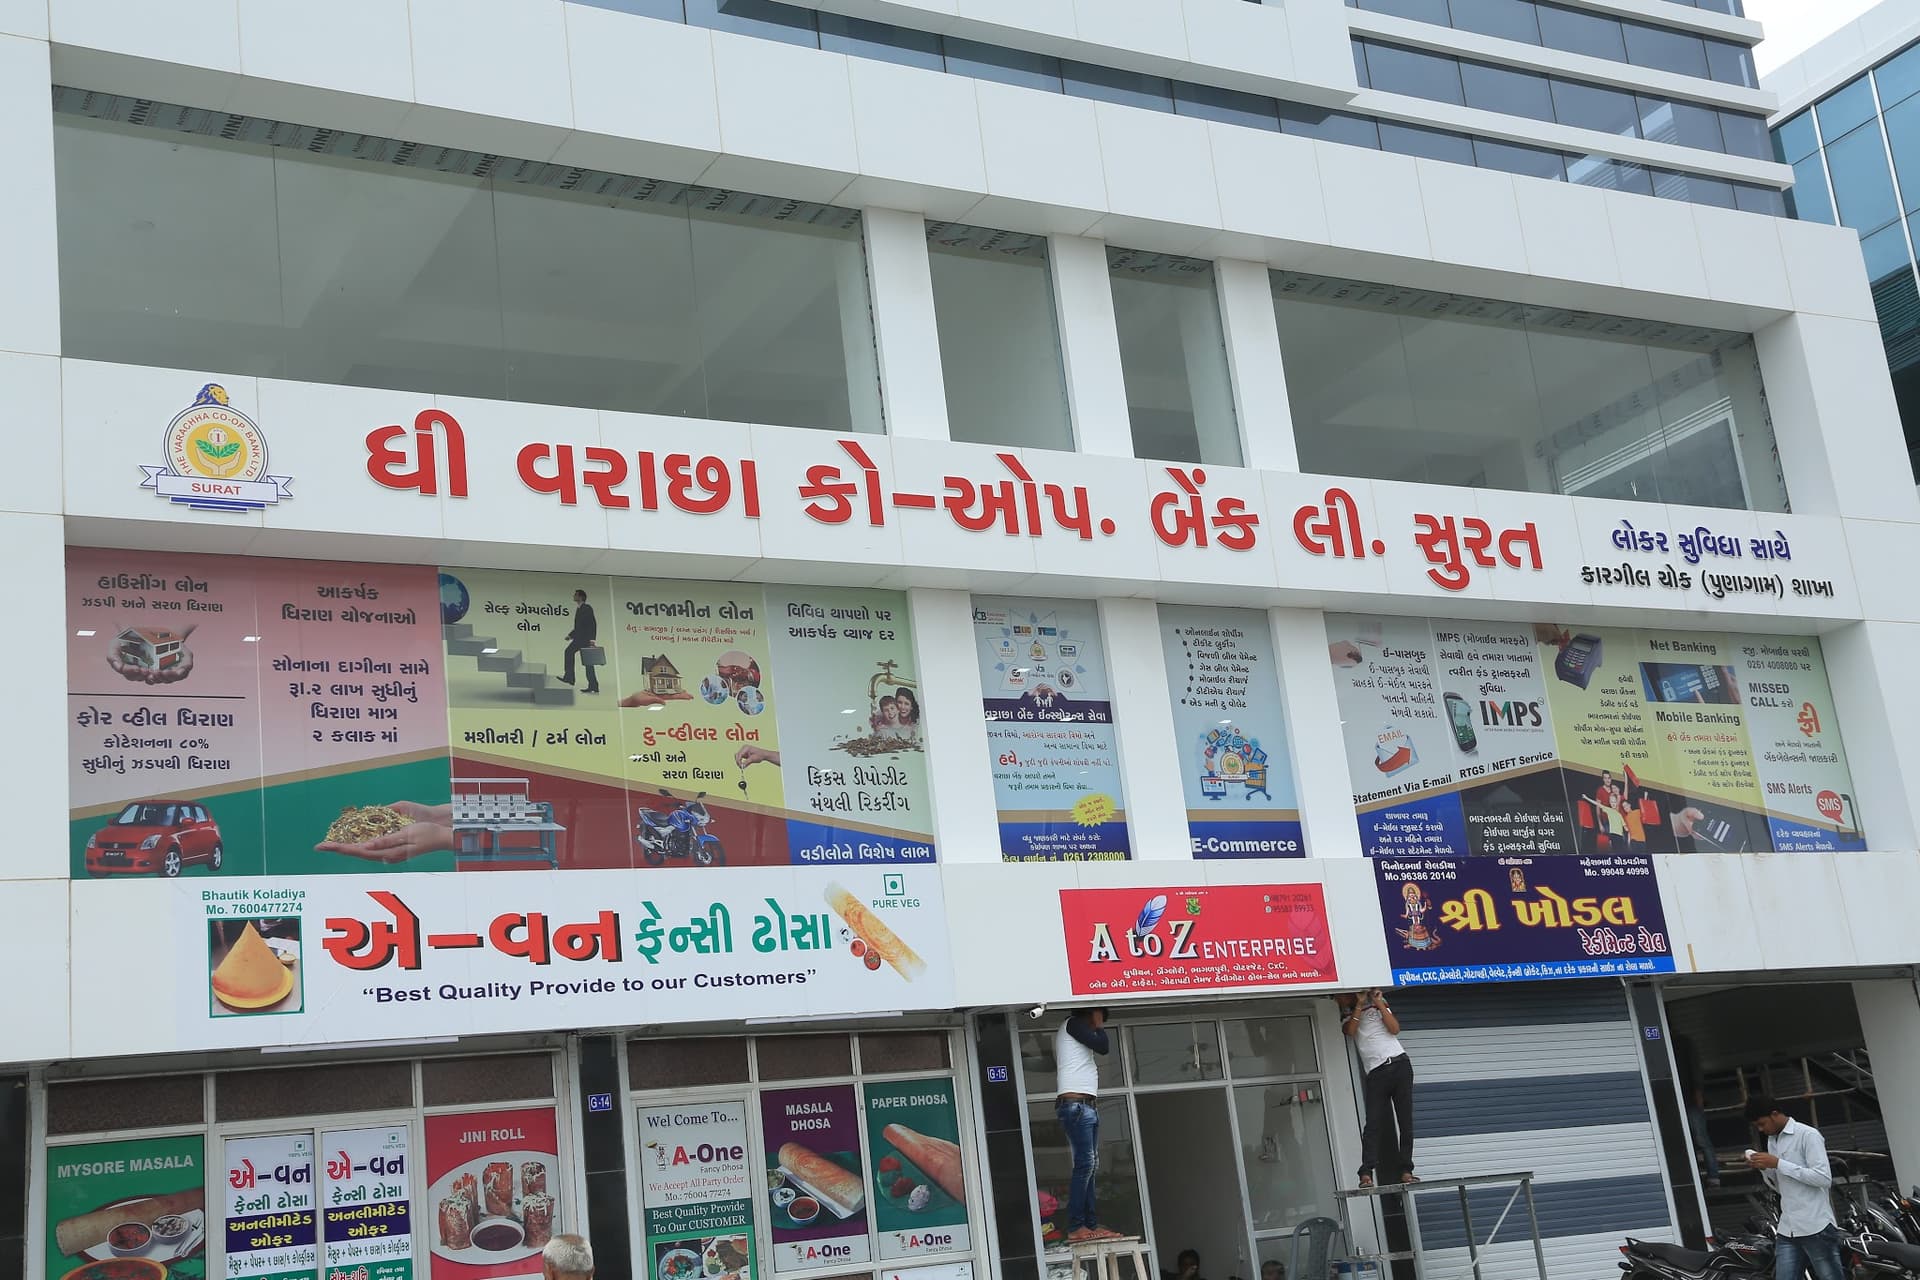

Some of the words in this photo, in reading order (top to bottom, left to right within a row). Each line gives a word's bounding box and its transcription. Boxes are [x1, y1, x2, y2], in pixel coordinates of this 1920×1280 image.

[174, 412, 210, 453] VARACHHA
[245, 431, 260, 458] BANK
[176, 456, 193, 475] THE
[191, 482, 242, 495] SURAT
[516, 442, 762, 520] વરાછા
[798, 439, 1117, 540] કો-ઓપ.
[1150, 466, 1260, 552] બેંક
[1292, 487, 1386, 560] લી.
[1412, 513, 1544, 591] સુરત
[1611, 519, 1669, 552] લોકર
[1750, 530, 1792, 561] સાથે
[97, 574, 166, 591] હાઉસીંગ
[175, 575, 208, 593] લોન
[1580, 563, 1651, 587] કારગીલ
[1658, 564, 1692, 590] ચોક
[1701, 569, 1784, 600] (પુણાગામ)
[1792, 578, 1835, 597] શાખા
[317, 583, 379, 601] આકર્ષક
[82, 597, 116, 609] ઝડપી
[122, 597, 149, 609] અને
[152, 600, 182, 611] સરળ
[186, 599, 223, 613] ધિરાણ
[281, 603, 332, 622] ધિરાણ
[341, 607, 417, 625] યોજનાઓ
[625, 600, 711, 619] જાતજામીન
[718, 601, 754, 621] લોન
[517, 620, 541, 632] લોન
[788, 624, 837, 639] આકર્ષક
[843, 629, 873, 640] વ્યાજ
[879, 630, 895, 641] દર
[1650, 640, 1669, 651] Net
[1673, 640, 1717, 656] Banking
[272, 657, 330, 672] સોનાના
[337, 658, 392, 674] દાગીના
[400, 658, 429, 675] સામે
[330, 683, 364, 697] લાખ
[371, 683, 418, 703] સુધીનું
[1749, 682, 1790, 694] MISSED
[1750, 697, 1779, 708] CALL
[76, 708, 113, 725] ફોર
[121, 708, 168, 727] વ્હીલ
[177, 709, 234, 728] ધિરાણ
[311, 704, 360, 720] ધિરાણ
[368, 705, 398, 720] માત્ર
[1479, 700, 1543, 727] IMPS
[1656, 711, 1693, 723] Mobile
[1695, 712, 1741, 726] Banking
[1797, 702, 1820, 738] ફ્રી
[103, 736, 172, 750] કોટેશનના
[463, 728, 524, 745] મશીનરી
[545, 728, 569, 745] ટર્મ
[574, 728, 607, 746] લોન
[642, 723, 717, 746] ટુ-વ્હીલર
[725, 723, 760, 741] લોન
[1378, 730, 1404, 743] EMAIL
[81, 756, 127, 776] સુધીનું
[131, 756, 181, 771] ઝડપથી
[187, 756, 231, 772] ધિરાણ
[1460, 766, 1486, 779] RTGS
[1492, 758, 1516, 771] NEFT
[1519, 751, 1553, 765] Service
[662, 770, 689, 781] સરળ
[692, 768, 724, 781] ધિરાણ
[853, 766, 909, 786] ડીપોઝીટ
[1403, 781, 1420, 793] Via
[1422, 775, 1452, 789] E-mail
[1767, 783, 1785, 794] SMS
[1788, 783, 1813, 795] Alerts
[809, 791, 852, 812] મંથલી
[1819, 798, 1840, 811] SMS
[800, 843, 853, 861] વડીલોને
[859, 843, 895, 859] વિશેષ
[901, 845, 930, 859] લાભ
[1191, 837, 1297, 852] E-Commerce
[1430, 872, 1456, 880] 20140
[201, 889, 250, 902] Bhautik
[252, 888, 306, 902] Koladiya
[872, 899, 898, 909] PURE
[899, 898, 921, 908] VEG
[206, 904, 228, 915] Mo.
[232, 901, 303, 914] 7600477274
[1439, 888, 1501, 931] શ્રી
[1512, 886, 1639, 929] ખોડલ
[322, 890, 623, 971] એ-વન
[635, 901, 733, 965] ફેન્સી
[752, 898, 832, 953] ઢોસા
[1638, 925, 1667, 953] રોલ
[1088, 923, 1120, 962] A
[1125, 929, 1163, 958] to
[1168, 920, 1199, 959] Z
[1203, 938, 1317, 959] ENTERPRISE
[439, 981, 522, 1002] Quality
[530, 978, 616, 997] Provide
[623, 978, 644, 992] to
[651, 977, 687, 991] our
[785, 1101, 833, 1116] MASALA
[871, 1096, 908, 1110] PAPER
[910, 1093, 948, 1106] DHOSA
[647, 1114, 671, 1127] Wel
[674, 1112, 708, 1126] Come
[711, 1111, 738, 1123] To...
[790, 1117, 831, 1132] DHOSA
[460, 1130, 486, 1144] JINI
[490, 1127, 525, 1141] ROLL
[672, 1143, 743, 1166] A-One
[57, 1160, 125, 1179] MYSORE
[130, 1154, 194, 1172] MASALA
[229, 1159, 311, 1189] એ-વન
[327, 1150, 405, 1180] એ-વન
[663, 1179, 689, 1192] Accept
[690, 1177, 700, 1187] All
[702, 1176, 720, 1188] Party
[721, 1175, 744, 1185] Order
[331, 1185, 366, 1204] ફેન્સી
[372, 1182, 402, 1199] ઢોસા
[234, 1194, 270, 1214] ફેન્સી
[277, 1191, 308, 1208] ઢોસા
[652, 1208, 673, 1220] Best
[674, 1205, 709, 1217] Quality
[710, 1201, 745, 1213] Provide
[327, 1203, 407, 1222] અનલીમીટેડ
[229, 1213, 312, 1232] અનલીમીટેડ
[347, 1223, 388, 1237] ઓફર
[653, 1223, 667, 1234] To
[668, 1221, 687, 1232] Our
[688, 1214, 746, 1230] CUSTOMER
[250, 1233, 293, 1248] ઓફર
[909, 1232, 952, 1248] A-One
[806, 1244, 851, 1260] A-One
